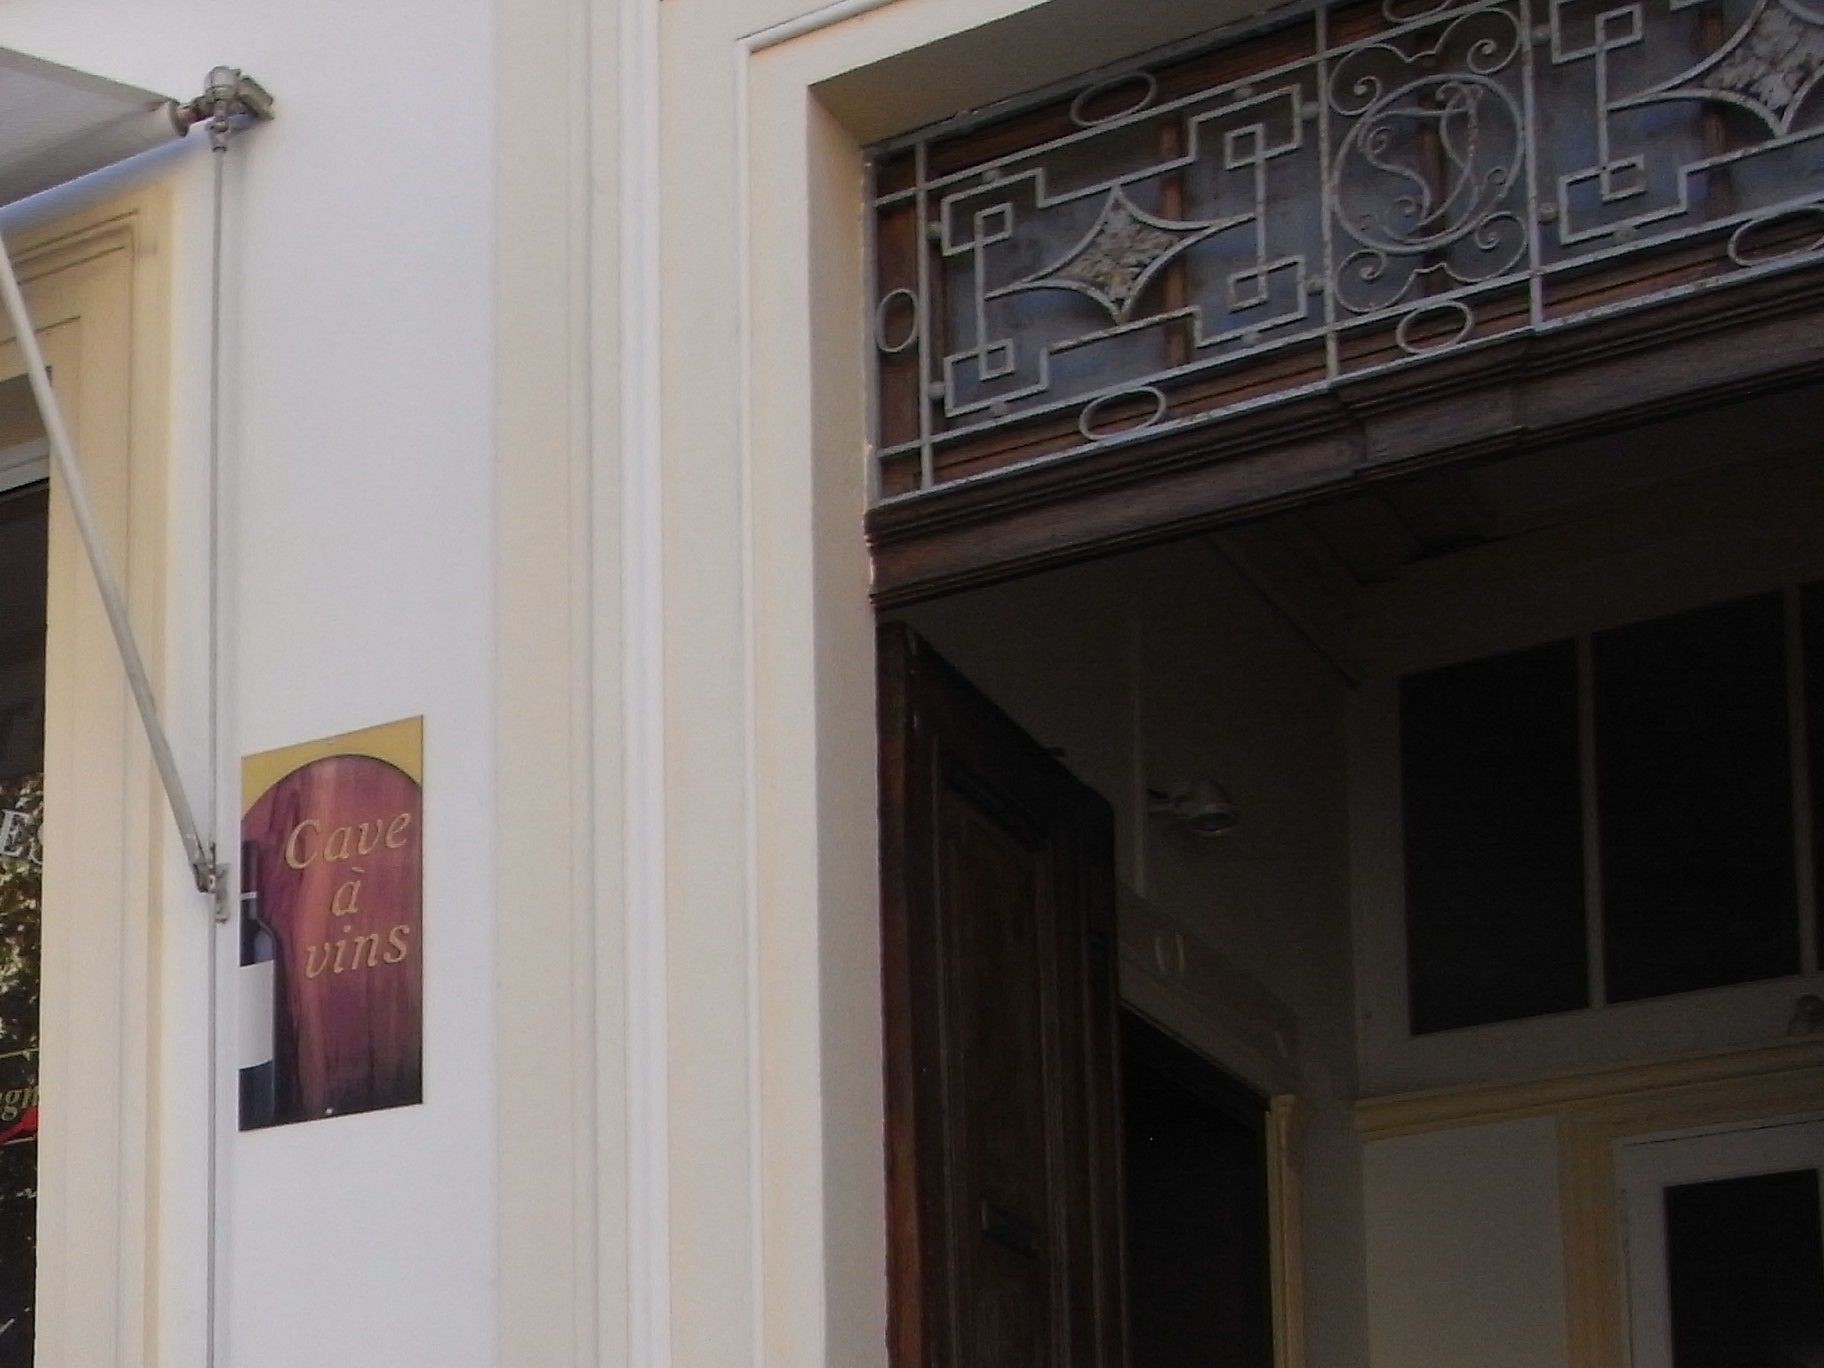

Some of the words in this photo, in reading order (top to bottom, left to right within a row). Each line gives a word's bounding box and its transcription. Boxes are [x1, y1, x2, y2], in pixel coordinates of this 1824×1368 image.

[284, 811, 412, 870] Cave
[331, 866, 365, 917] à
[304, 923, 411, 979] vins
